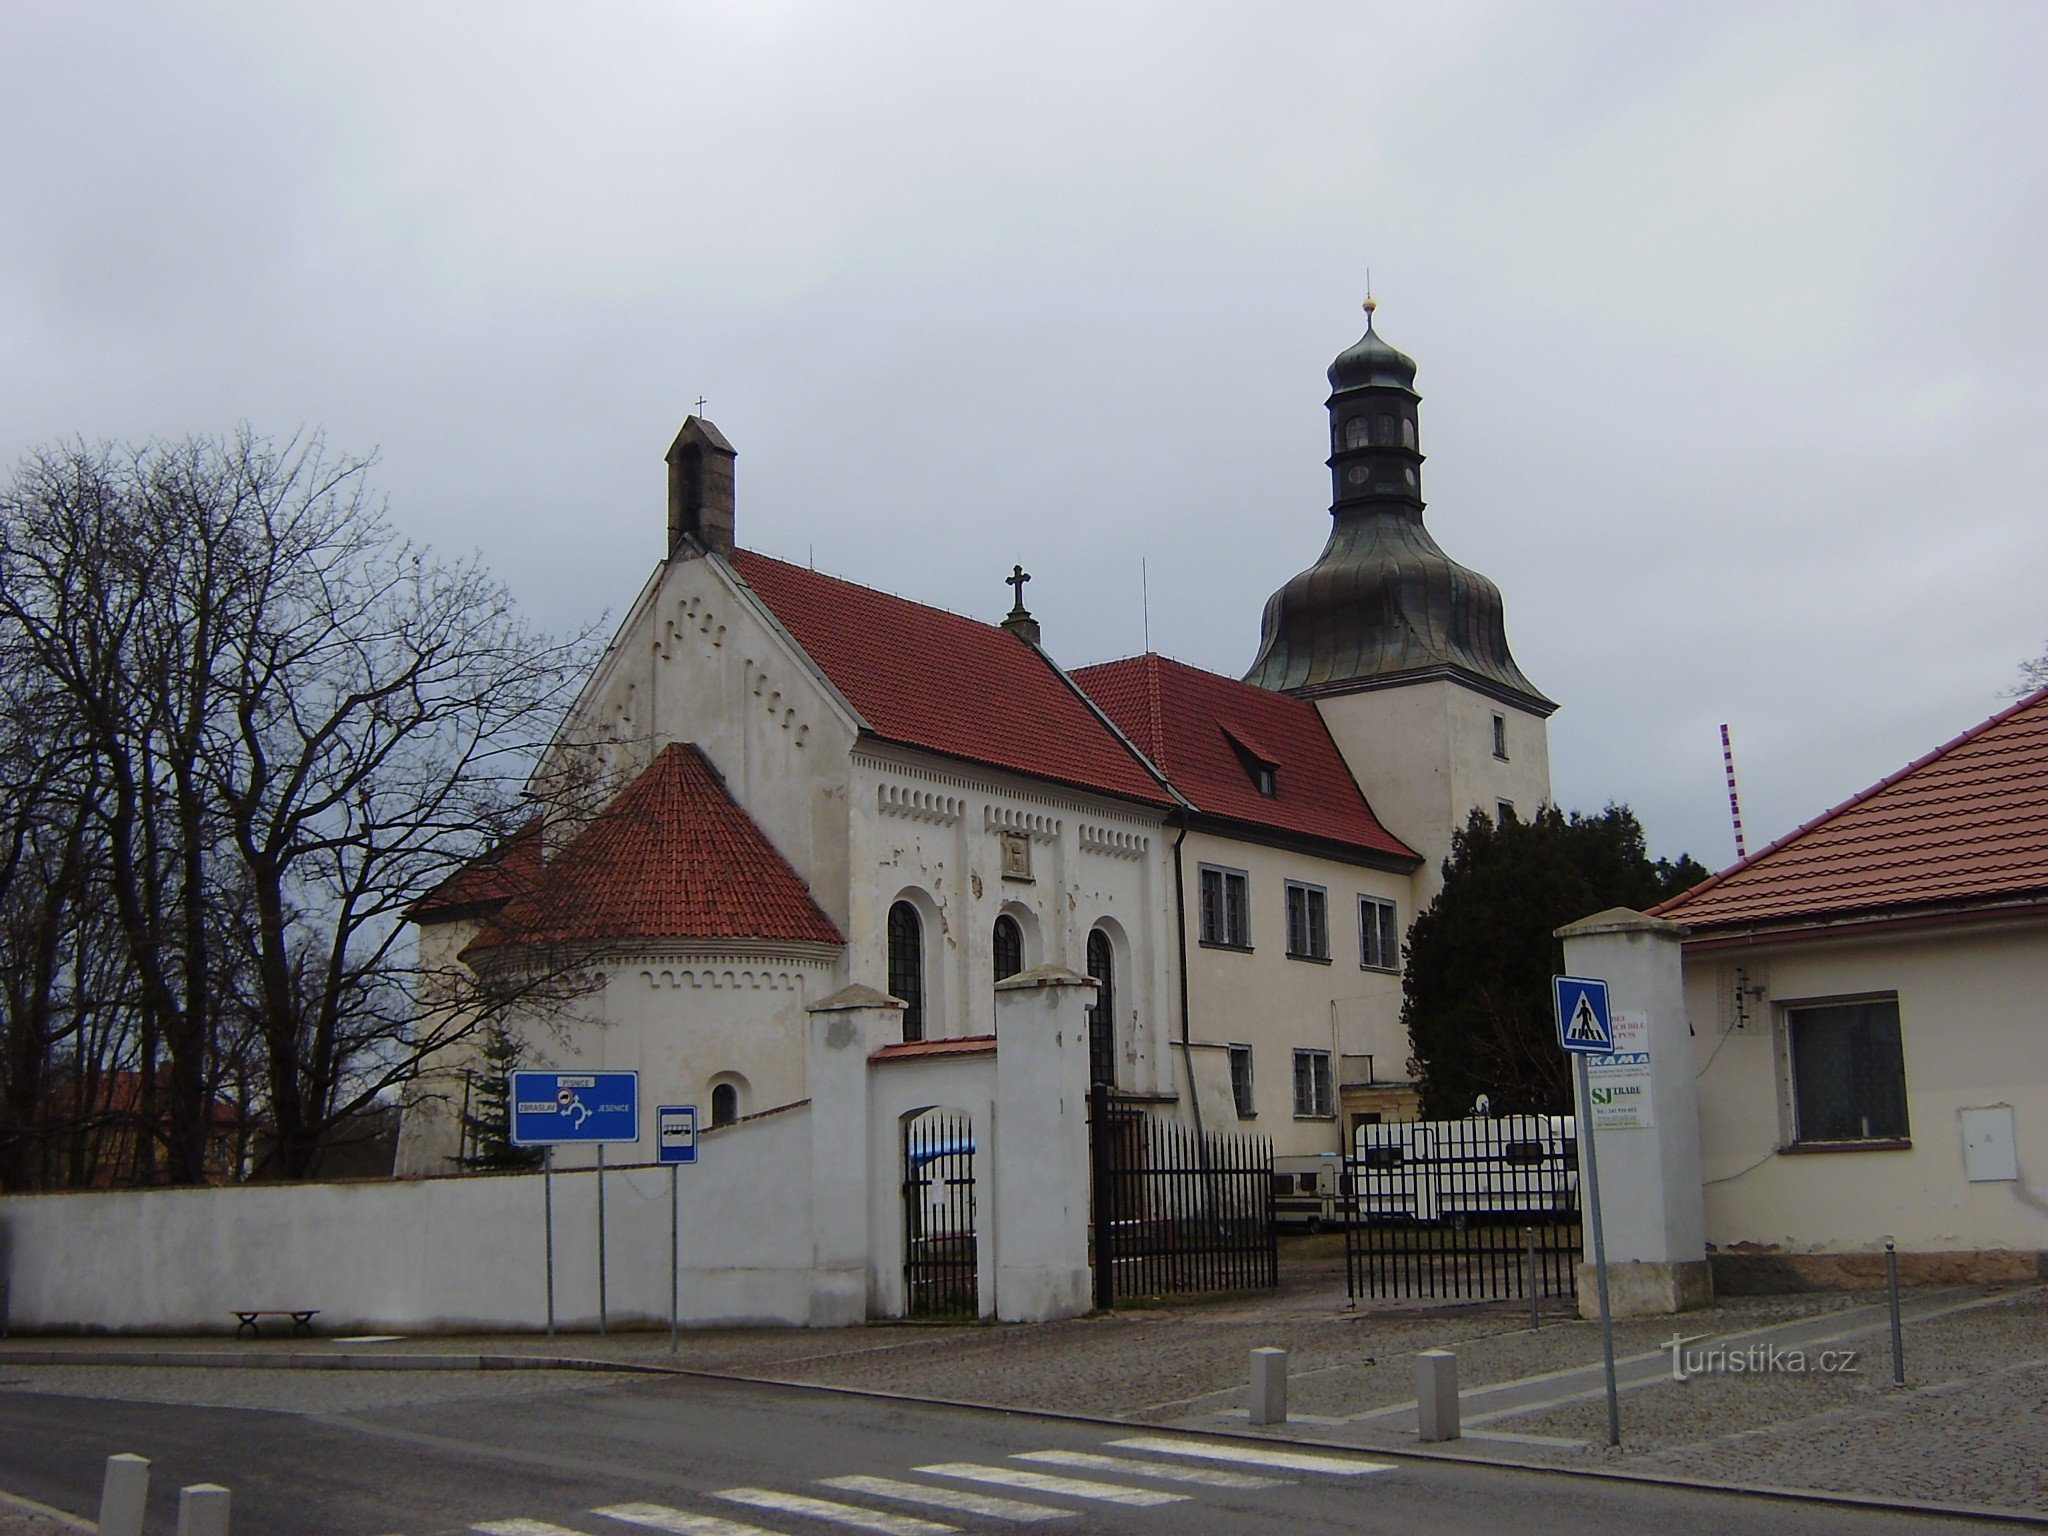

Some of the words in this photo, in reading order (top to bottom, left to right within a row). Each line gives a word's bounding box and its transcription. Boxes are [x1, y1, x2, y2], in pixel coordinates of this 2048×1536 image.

[1592, 1088, 1612, 1105] SJ
[1614, 1086, 1641, 1095] TRADE
[519, 1103, 556, 1112] ZBRASLAV
[598, 1104, 630, 1113] JESENICE
